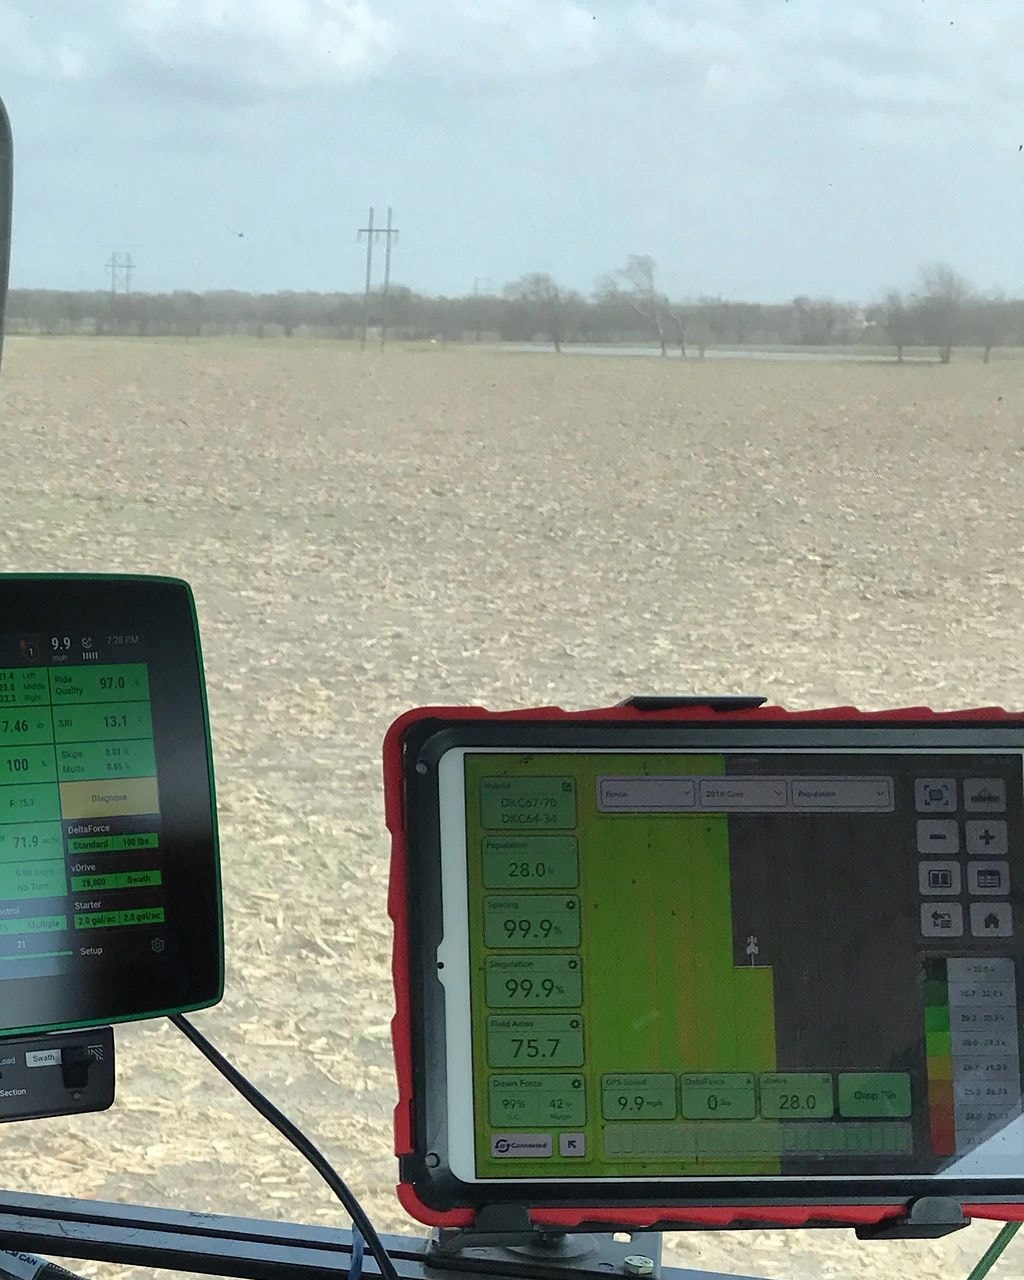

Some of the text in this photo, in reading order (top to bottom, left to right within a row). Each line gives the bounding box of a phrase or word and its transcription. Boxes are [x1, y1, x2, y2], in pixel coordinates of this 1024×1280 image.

[51, 636, 72, 650] 9.9
[55, 675, 72, 684] Ride
[99, 676, 125, 690] 97.0
[56, 686, 83, 696] Quality
[2, 720, 29, 733] 7.46
[103, 715, 127, 728] 13.1
[7, 759, 29, 772] 100
[92, 793, 128, 804] Diagnose
[68, 824, 111, 834] DeltaForce
[13, 835, 39, 848] 71.9
[73, 839, 109, 850] Standard
[137, 837, 150, 846] lbs
[486, 841, 527, 850] Population
[71, 863, 96, 873] vDrive
[127, 875, 152, 884] Swath
[75, 901, 102, 910] Starter
[488, 901, 519, 909] Spacing
[91, 914, 116, 926] gal/ac
[136, 911, 160, 923] gal/ac
[80, 946, 103, 956] Setup
[511, 1039, 560, 1058] 75.7
[33, 1053, 56, 1063] Swath
[492, 1079, 543, 1088] Down Force
[0, 1087, 27, 1097] Section
[617, 1096, 645, 1111] 9.9
[707, 1096, 719, 1111] 0
[779, 1095, 816, 1110] 28.0
